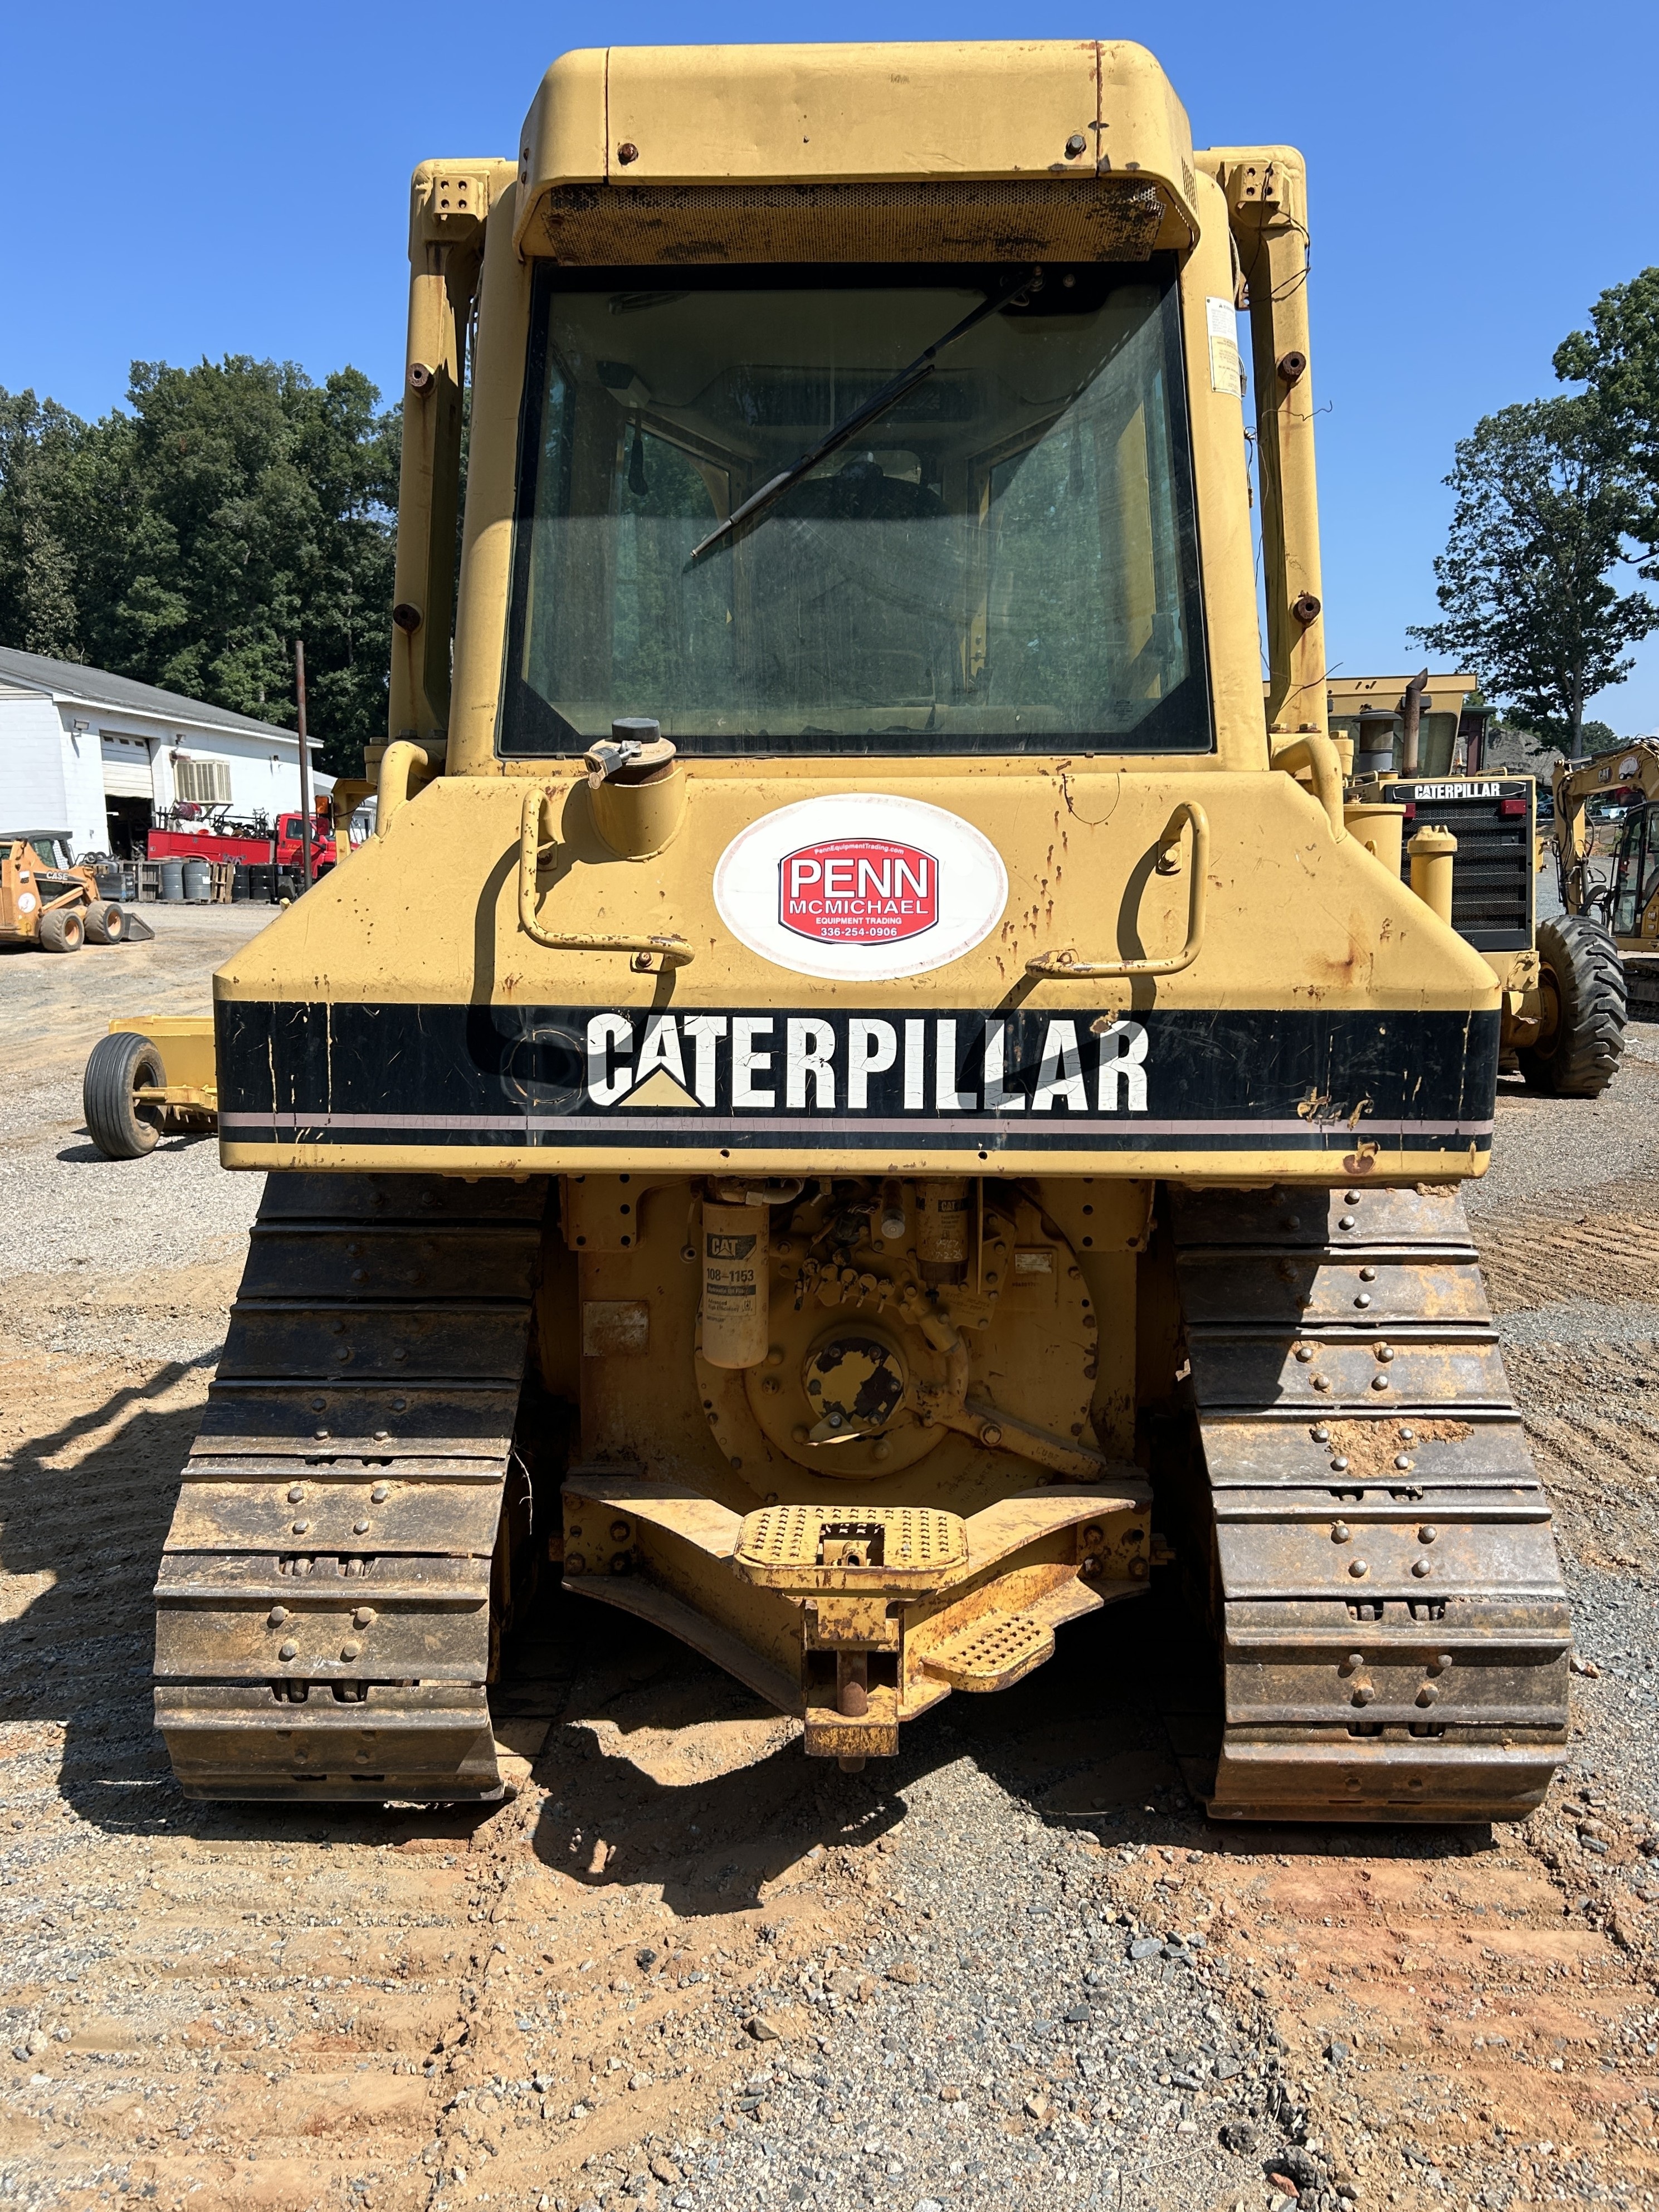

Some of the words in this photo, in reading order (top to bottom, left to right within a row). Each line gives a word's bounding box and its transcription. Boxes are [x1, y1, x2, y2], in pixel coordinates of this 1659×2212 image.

[1414, 783, 1500, 799] CATERPILLAR
[814, 843, 904, 855] PennEquipmentTrading.com
[46, 870, 69, 880] CASE
[790, 858, 929, 899] PENN
[789, 900, 929, 914] MCMICHAEL
[821, 927, 897, 936] 336-254-0906
[587, 1012, 1149, 1111] CATERPILLAR
[941, 1202, 955, 1212] CAT
[712, 1237, 738, 1257] CAT
[706, 1268, 754, 1282] 108-1153
